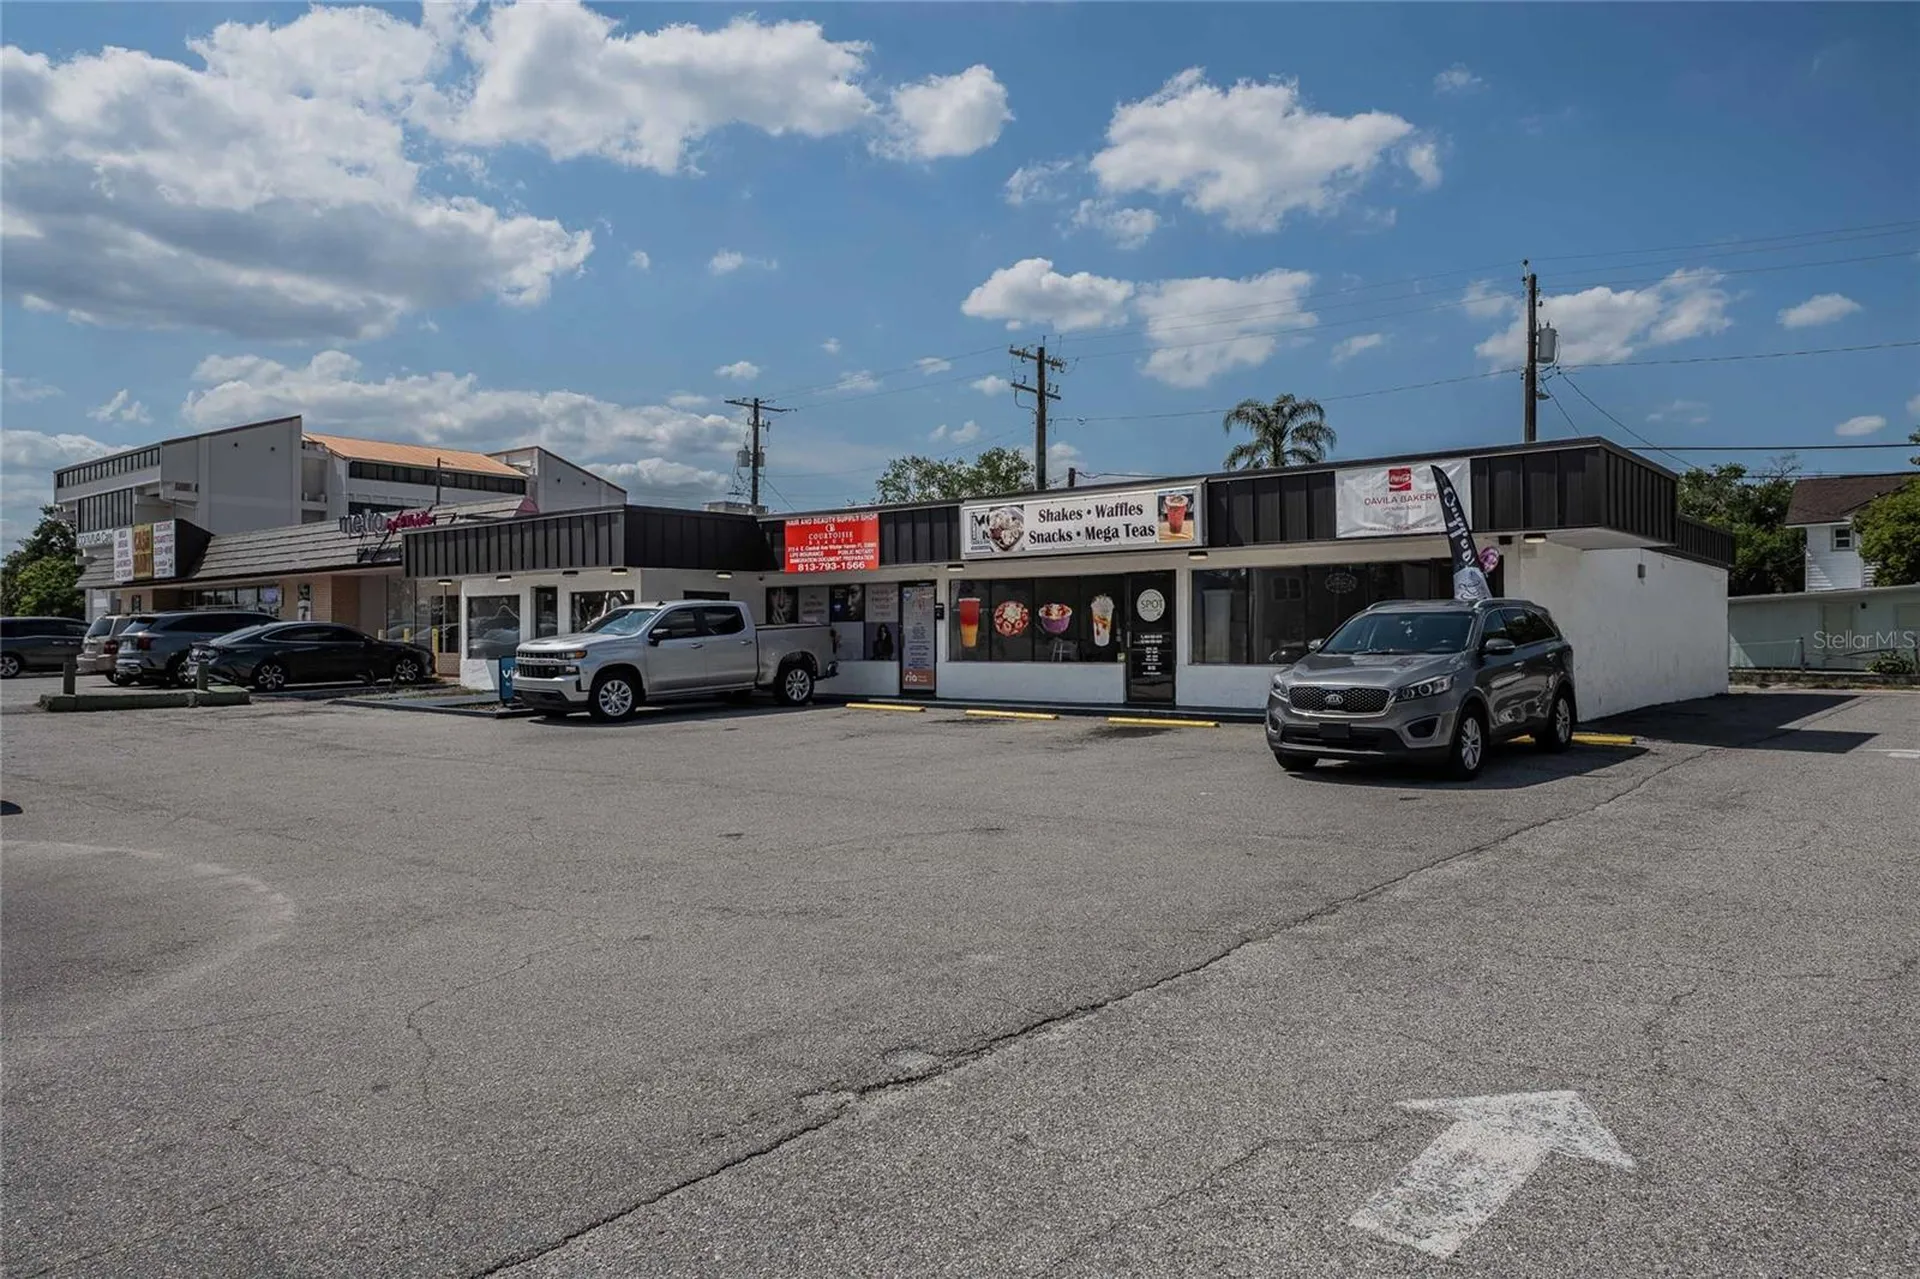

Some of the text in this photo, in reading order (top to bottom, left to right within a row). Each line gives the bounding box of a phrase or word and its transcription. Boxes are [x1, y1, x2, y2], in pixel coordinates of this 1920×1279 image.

[1364, 493, 1438, 506] DAVILA BAKERY
[1037, 501, 1143, 523] Shakes Waffles
[836, 515, 860, 523] SUPPLY
[1028, 523, 1156, 545] Snacks Mega Teas
[798, 561, 865, 572] 813-793-1566
[1140, 599, 1164, 610] SPOT
